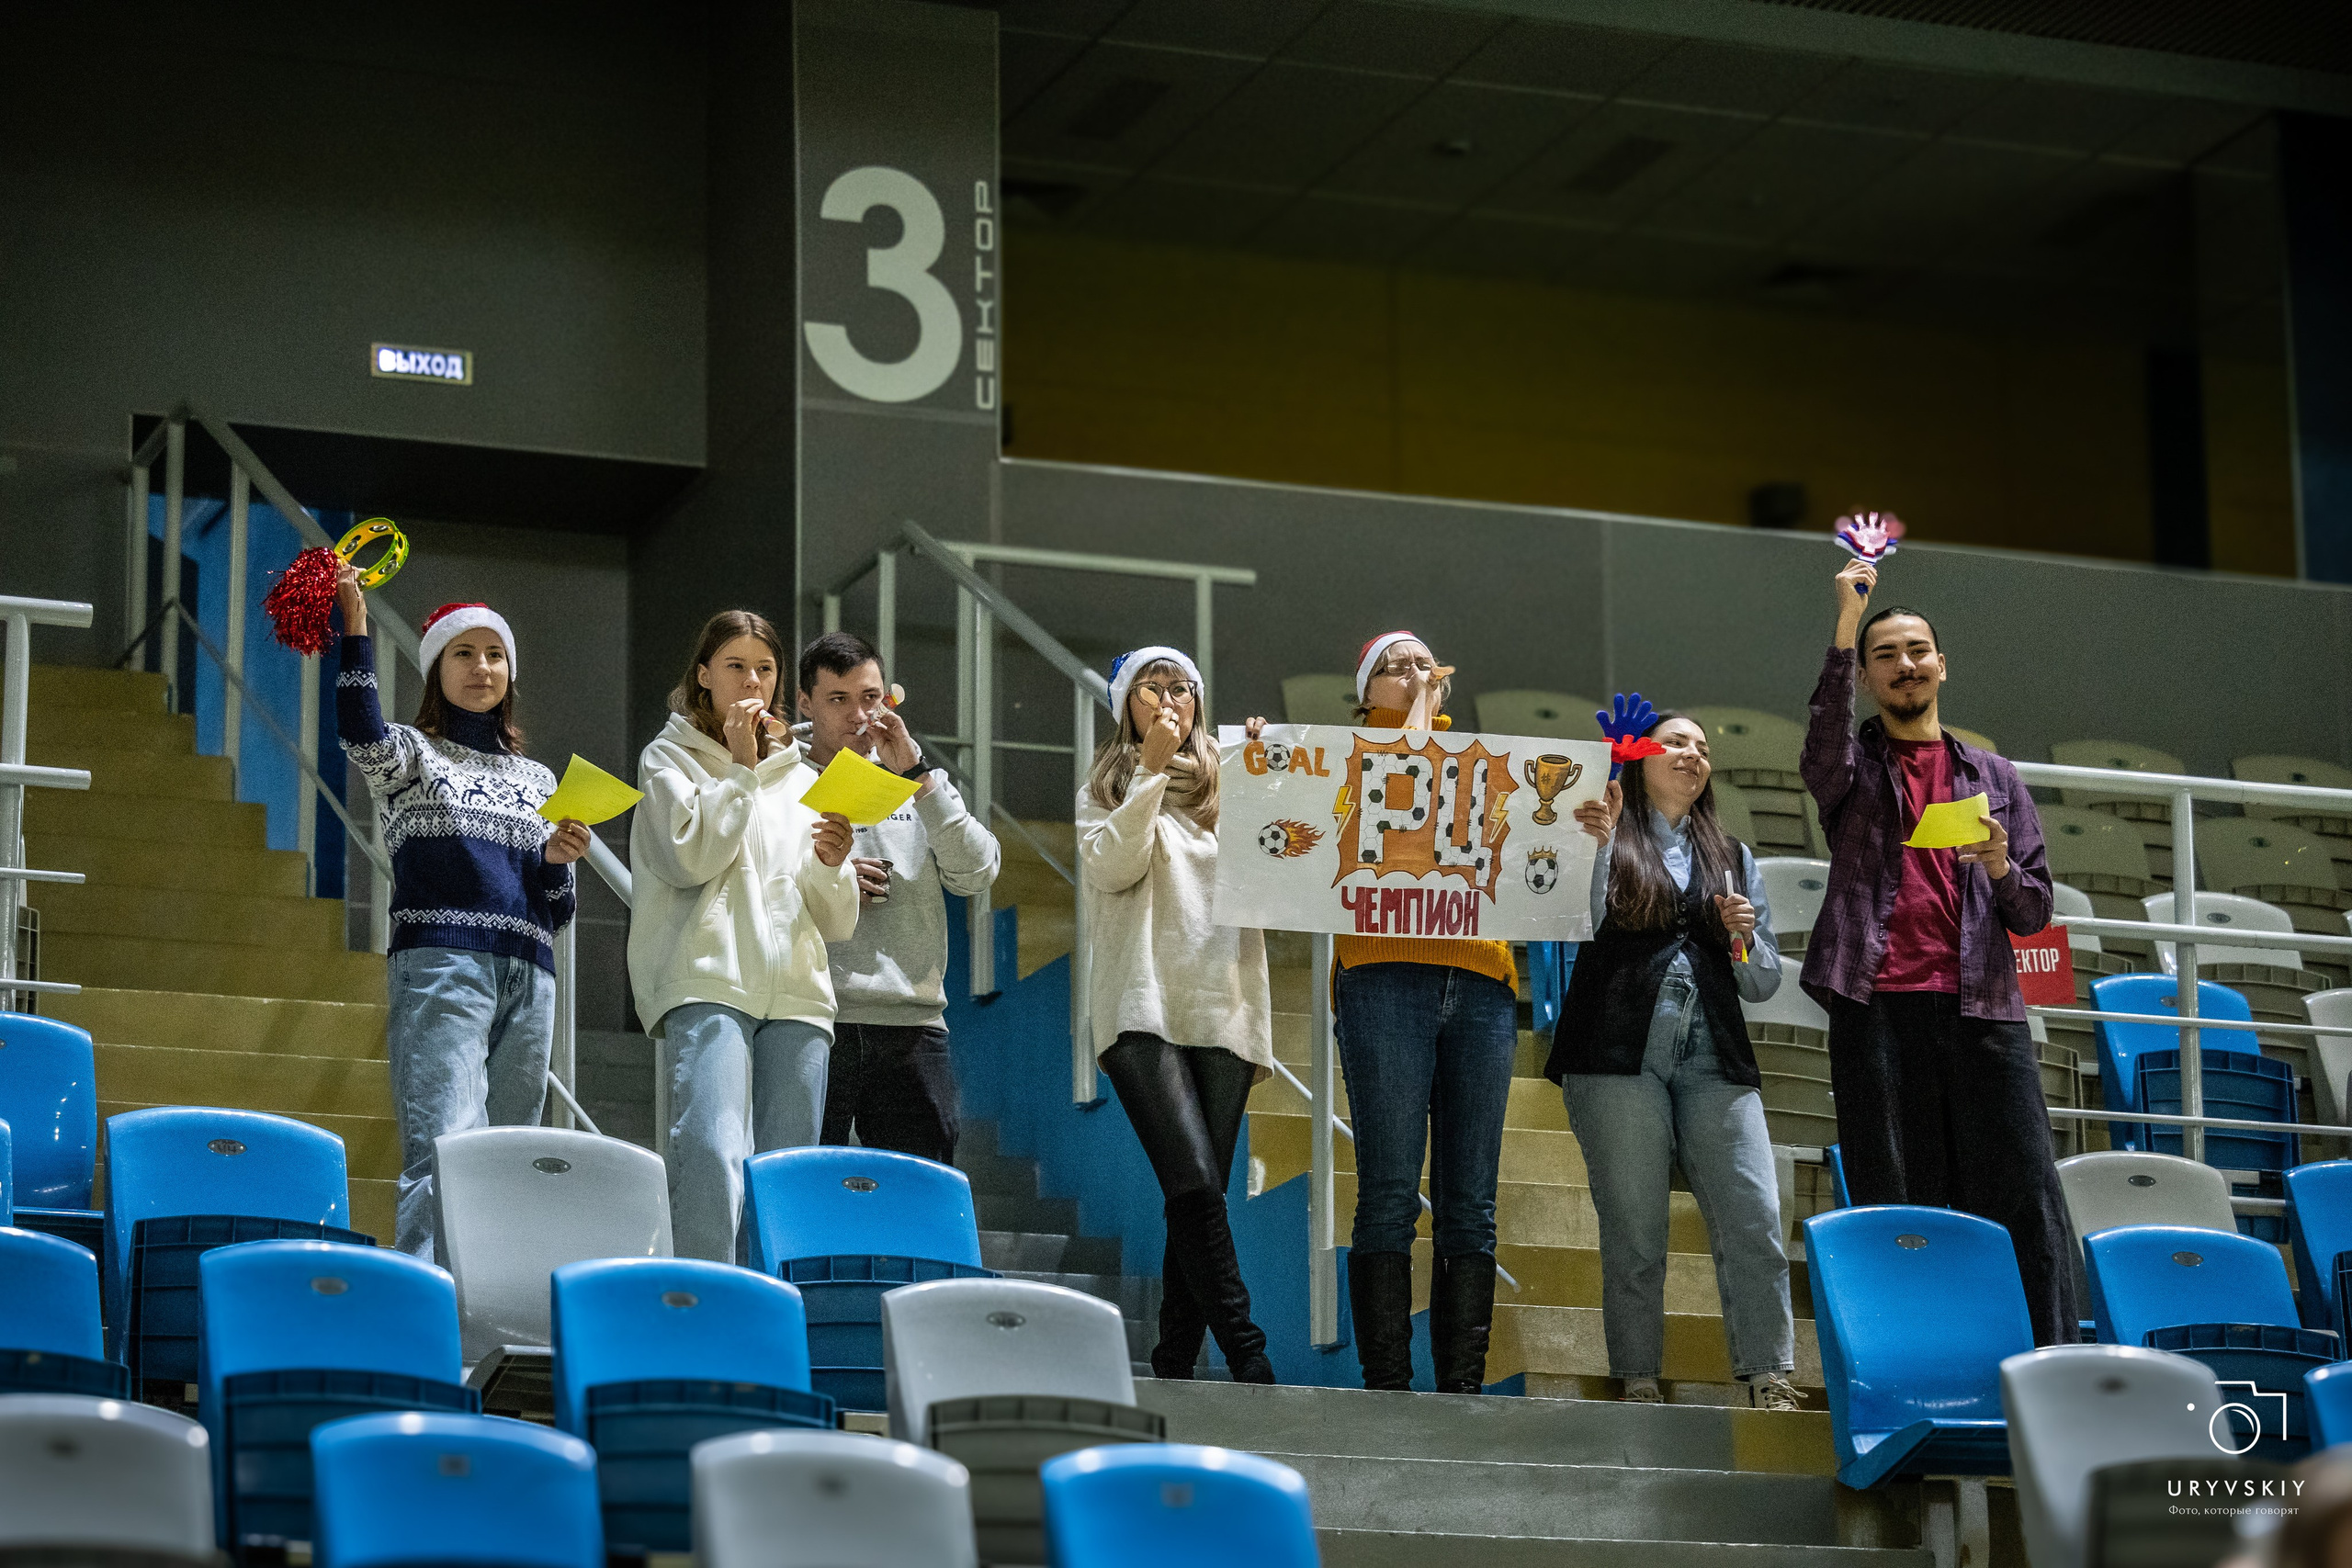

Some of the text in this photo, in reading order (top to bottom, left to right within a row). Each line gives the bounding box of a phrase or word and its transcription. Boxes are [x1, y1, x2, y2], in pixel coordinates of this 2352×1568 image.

[804, 165, 962, 402] 3
[975, 180, 994, 410] СЕКТОР
[378, 348, 464, 380] ВЫХОД
[1357, 751, 1493, 887] РЦ
[1341, 886, 1480, 936] ЧЕМПИОН
[2013, 948, 2060, 974] ЕКТОР
[851, 1181, 871, 1190] 46
